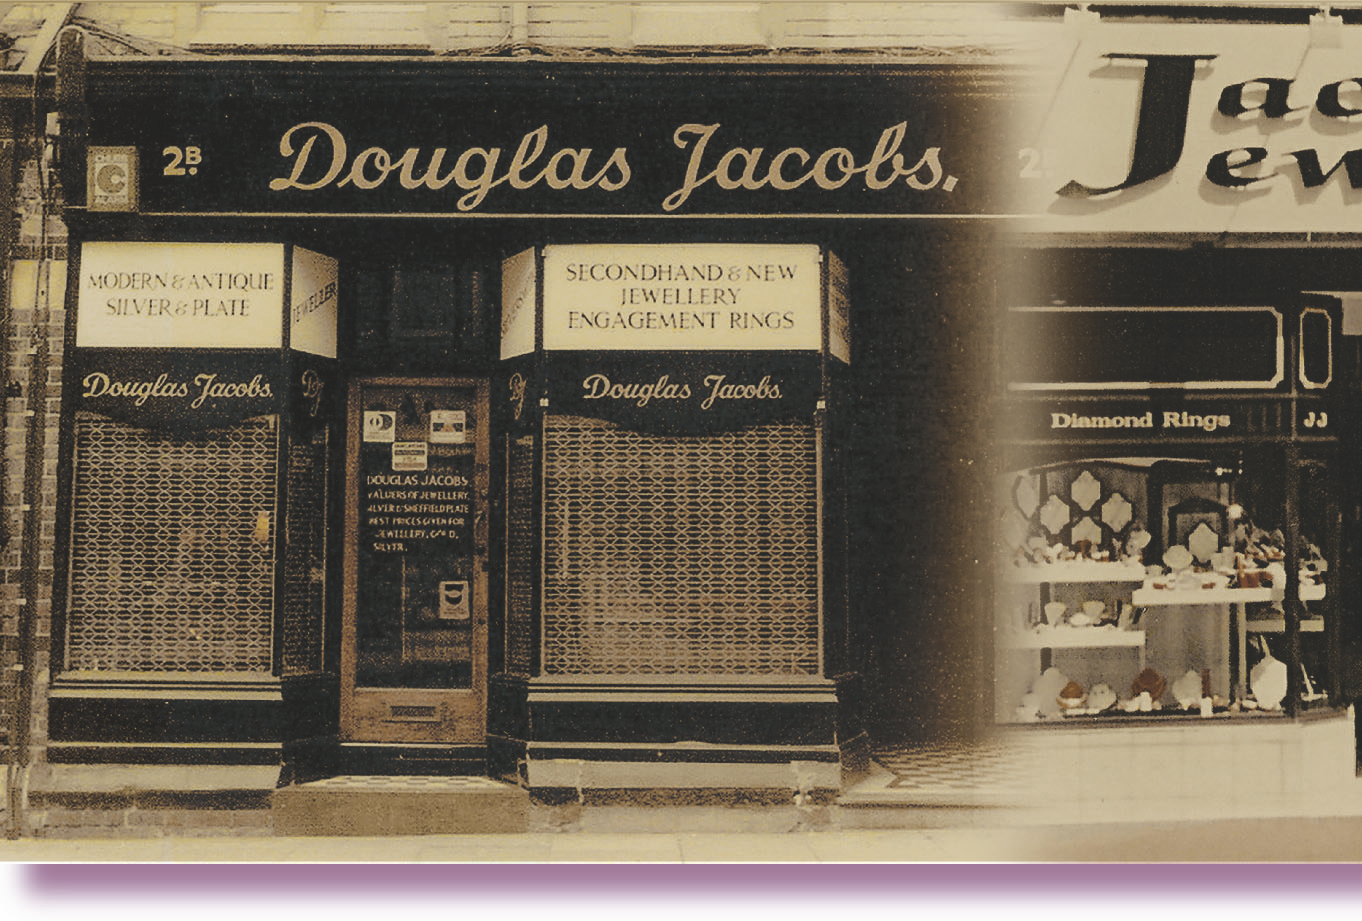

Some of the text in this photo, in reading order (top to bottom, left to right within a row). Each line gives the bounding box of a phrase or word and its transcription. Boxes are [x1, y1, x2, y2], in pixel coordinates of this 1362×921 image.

[270, 121, 959, 211] Douglas Jacobs.
[88, 272, 274, 291] MODERN & ANTIQUE
[566, 264, 798, 282] SECONDHAND & NEW
[621, 288, 742, 306] JEWELLERY
[106, 298, 171, 316] SILVER
[193, 298, 250, 317] PLATE
[568, 311, 795, 330] ENGAGEMENT RINGS
[82, 372, 274, 409] Douglas Jacobs.
[582, 373, 783, 410] Douglas Jacobs.
[1050, 411, 1231, 431] Diamond Rings
[367, 475, 469, 487] DOUGLAS JACOBS
